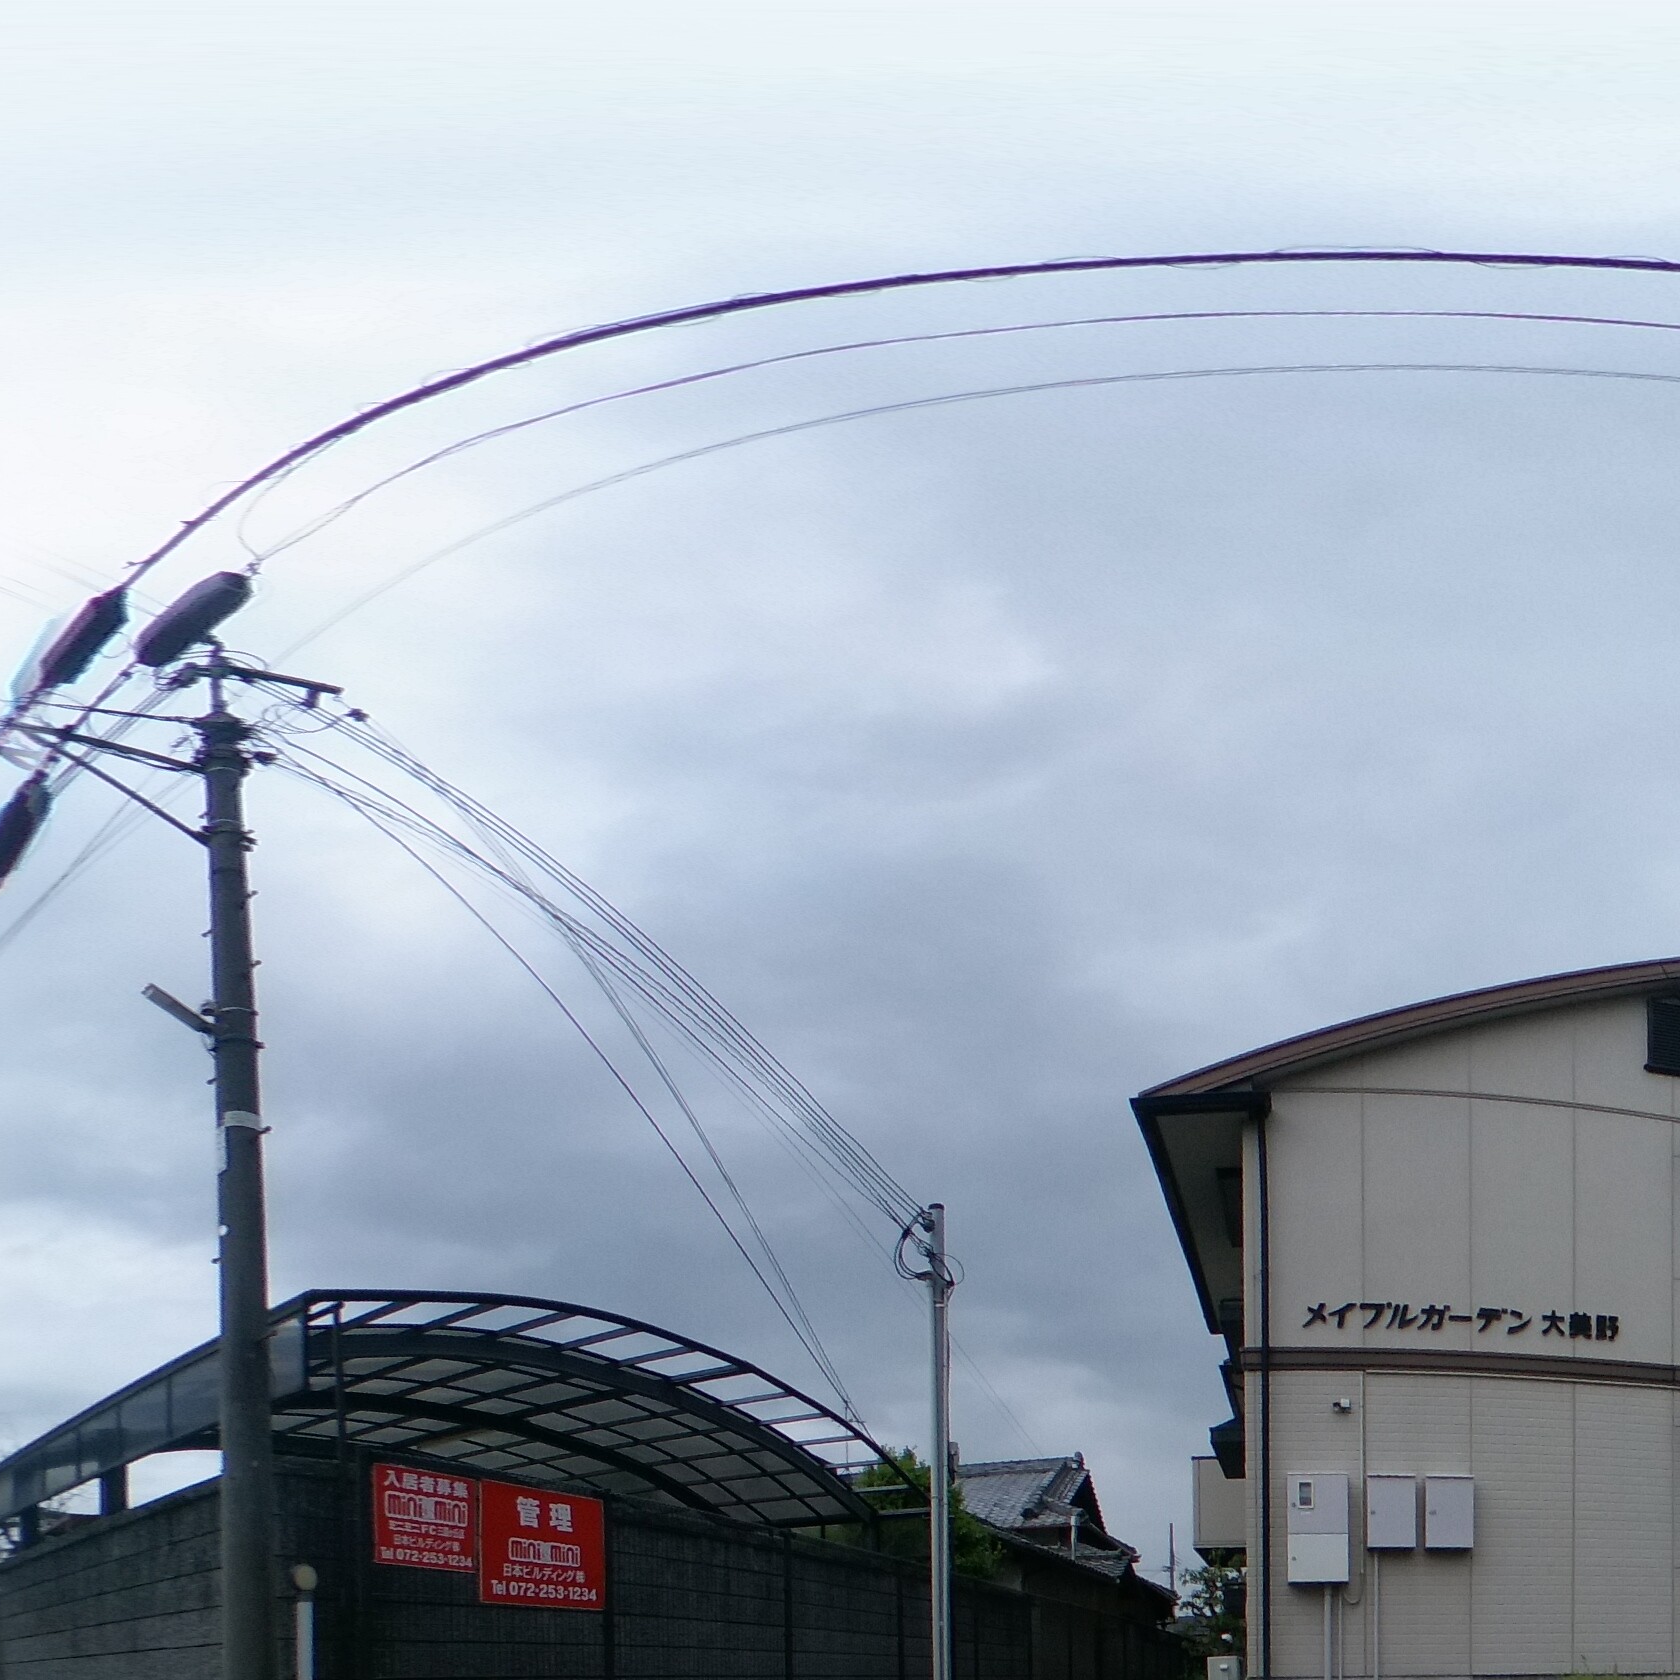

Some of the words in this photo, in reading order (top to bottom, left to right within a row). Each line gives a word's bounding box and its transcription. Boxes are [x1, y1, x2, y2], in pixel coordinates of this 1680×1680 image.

[1302, 1301, 1532, 1334] メイプルガーデン
[1542, 1310, 1619, 1341] 大美野
[384, 1470, 469, 1499] 入居者募集
[516, 1495, 574, 1533] 管理
[491, 1579, 506, 1595] Tel
